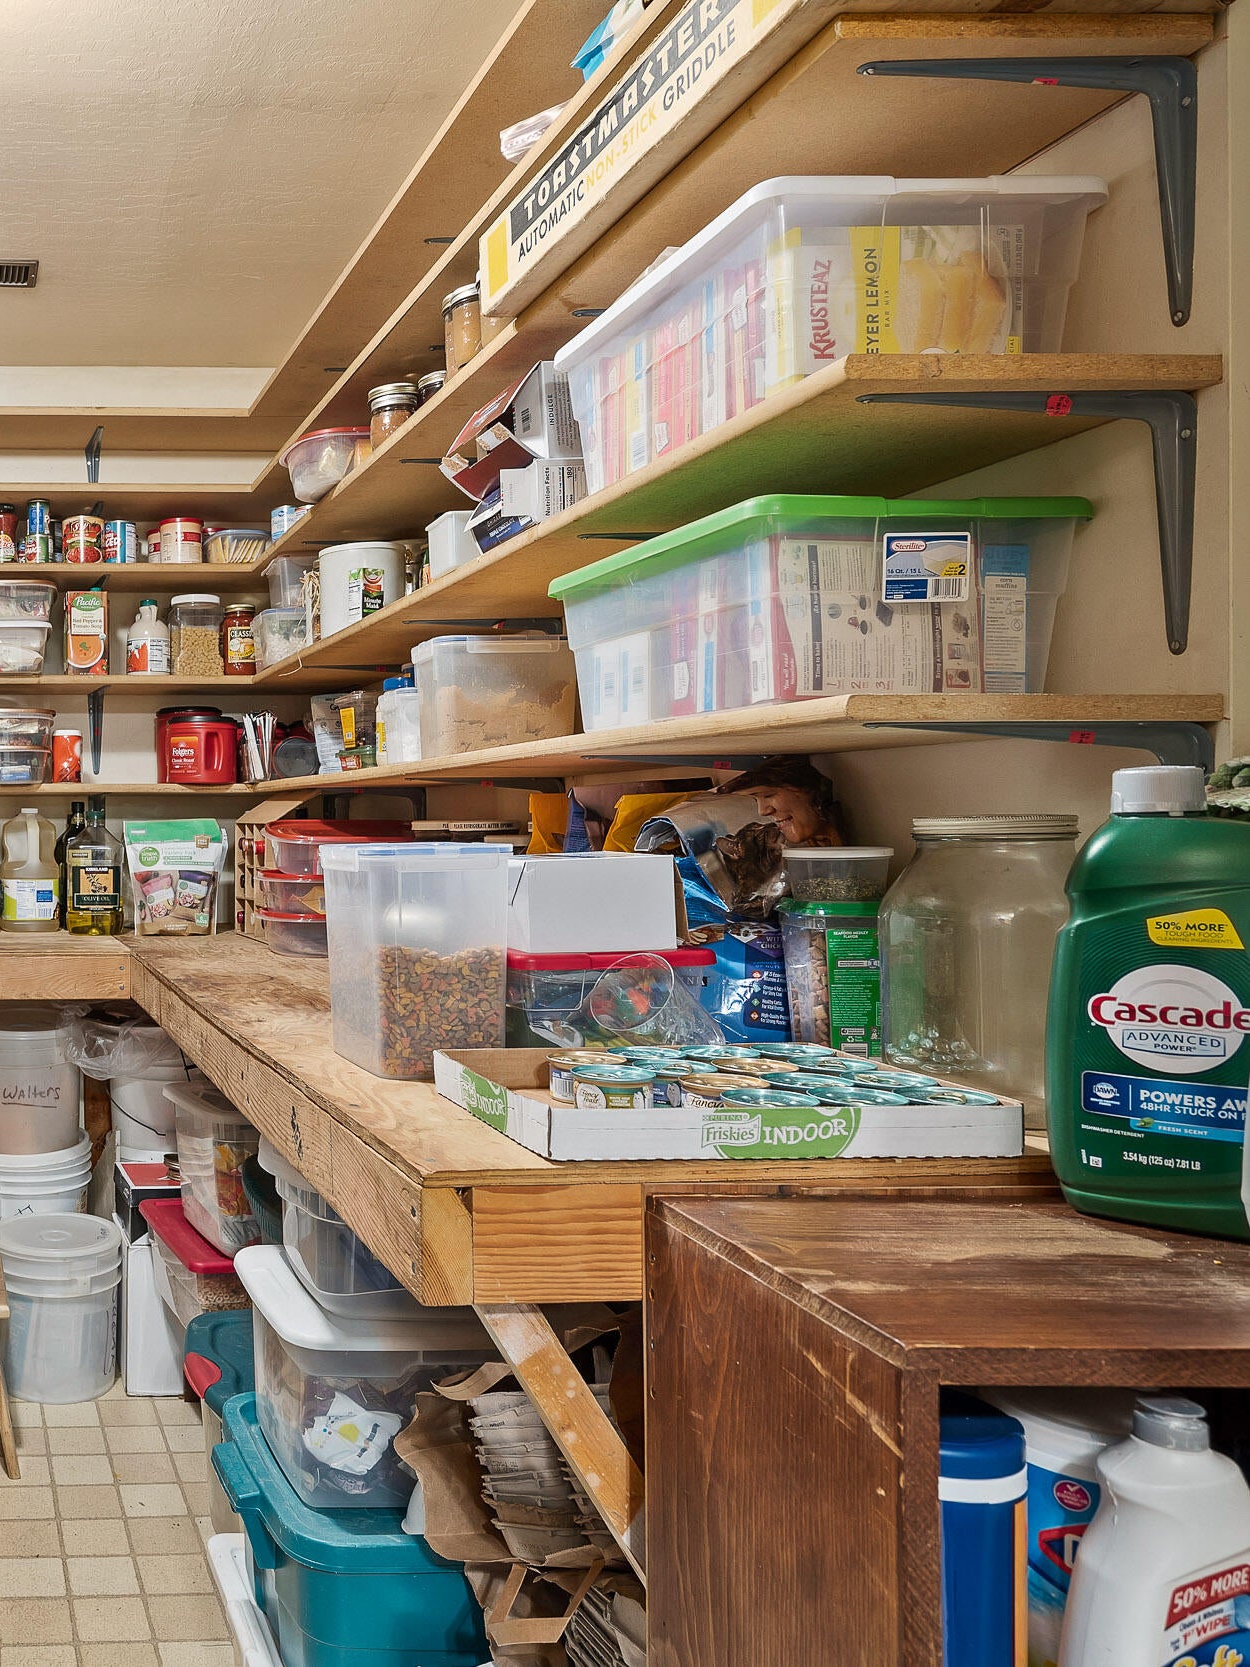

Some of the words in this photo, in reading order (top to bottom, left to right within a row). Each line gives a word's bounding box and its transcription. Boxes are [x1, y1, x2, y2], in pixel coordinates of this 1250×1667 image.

[523, 0, 723, 221] TOASTMASTER
[518, 180, 585, 262] AUTOMATIC
[586, 103, 656, 192] NON-STICK
[662, 19, 736, 111] GRIDDLE
[864, 248, 879, 307] LEMON
[808, 259, 837, 360] KRUSTEAZ
[866, 313, 879, 354] EYER
[894, 542, 924, 550] Sterilite
[958, 564, 966, 575] 2
[76, 595, 100, 607] Pacific
[230, 629, 254, 638] CLASSI
[172, 748, 194, 757] Folgers
[1155, 922, 1181, 930] 50%
[1185, 923, 1225, 932] MORE
[1091, 995, 1250, 1031] Cascade
[1127, 1032, 1221, 1048] ADVANCED
[1154, 1043, 1193, 1052] POWER
[1093, 1086, 1119, 1096] DAWN
[1140, 1089, 1217, 1109] POWERS
[1222, 1099, 1248, 1112] AW
[476, 1094, 505, 1115] INDOOR
[1140, 1102, 1171, 1113] 48HR
[1175, 1106, 1215, 1118] STUCK
[1218, 1110, 1237, 1121] ON
[706, 1126, 755, 1142] Friskies
[763, 1118, 848, 1145] INDOOR
[1081, 1124, 1113, 1134] DISHWASHER
[1114, 1129, 1145, 1138] DETERGENT
[1158, 1125, 1182, 1133] FRESH
[1184, 1128, 1208, 1136] SCENT
[1123, 1151, 1137, 1161] 3.54
[1138, 1153, 1147, 1165] kg
[1149, 1155, 1163, 1166] (125
[1164, 1157, 1175, 1169] oz)
[1191, 1161, 1201, 1170] LB
[1173, 1583, 1207, 1613] 50%
[1210, 1567, 1249, 1597] MORE
[1195, 1616, 1231, 1637] WIPE
